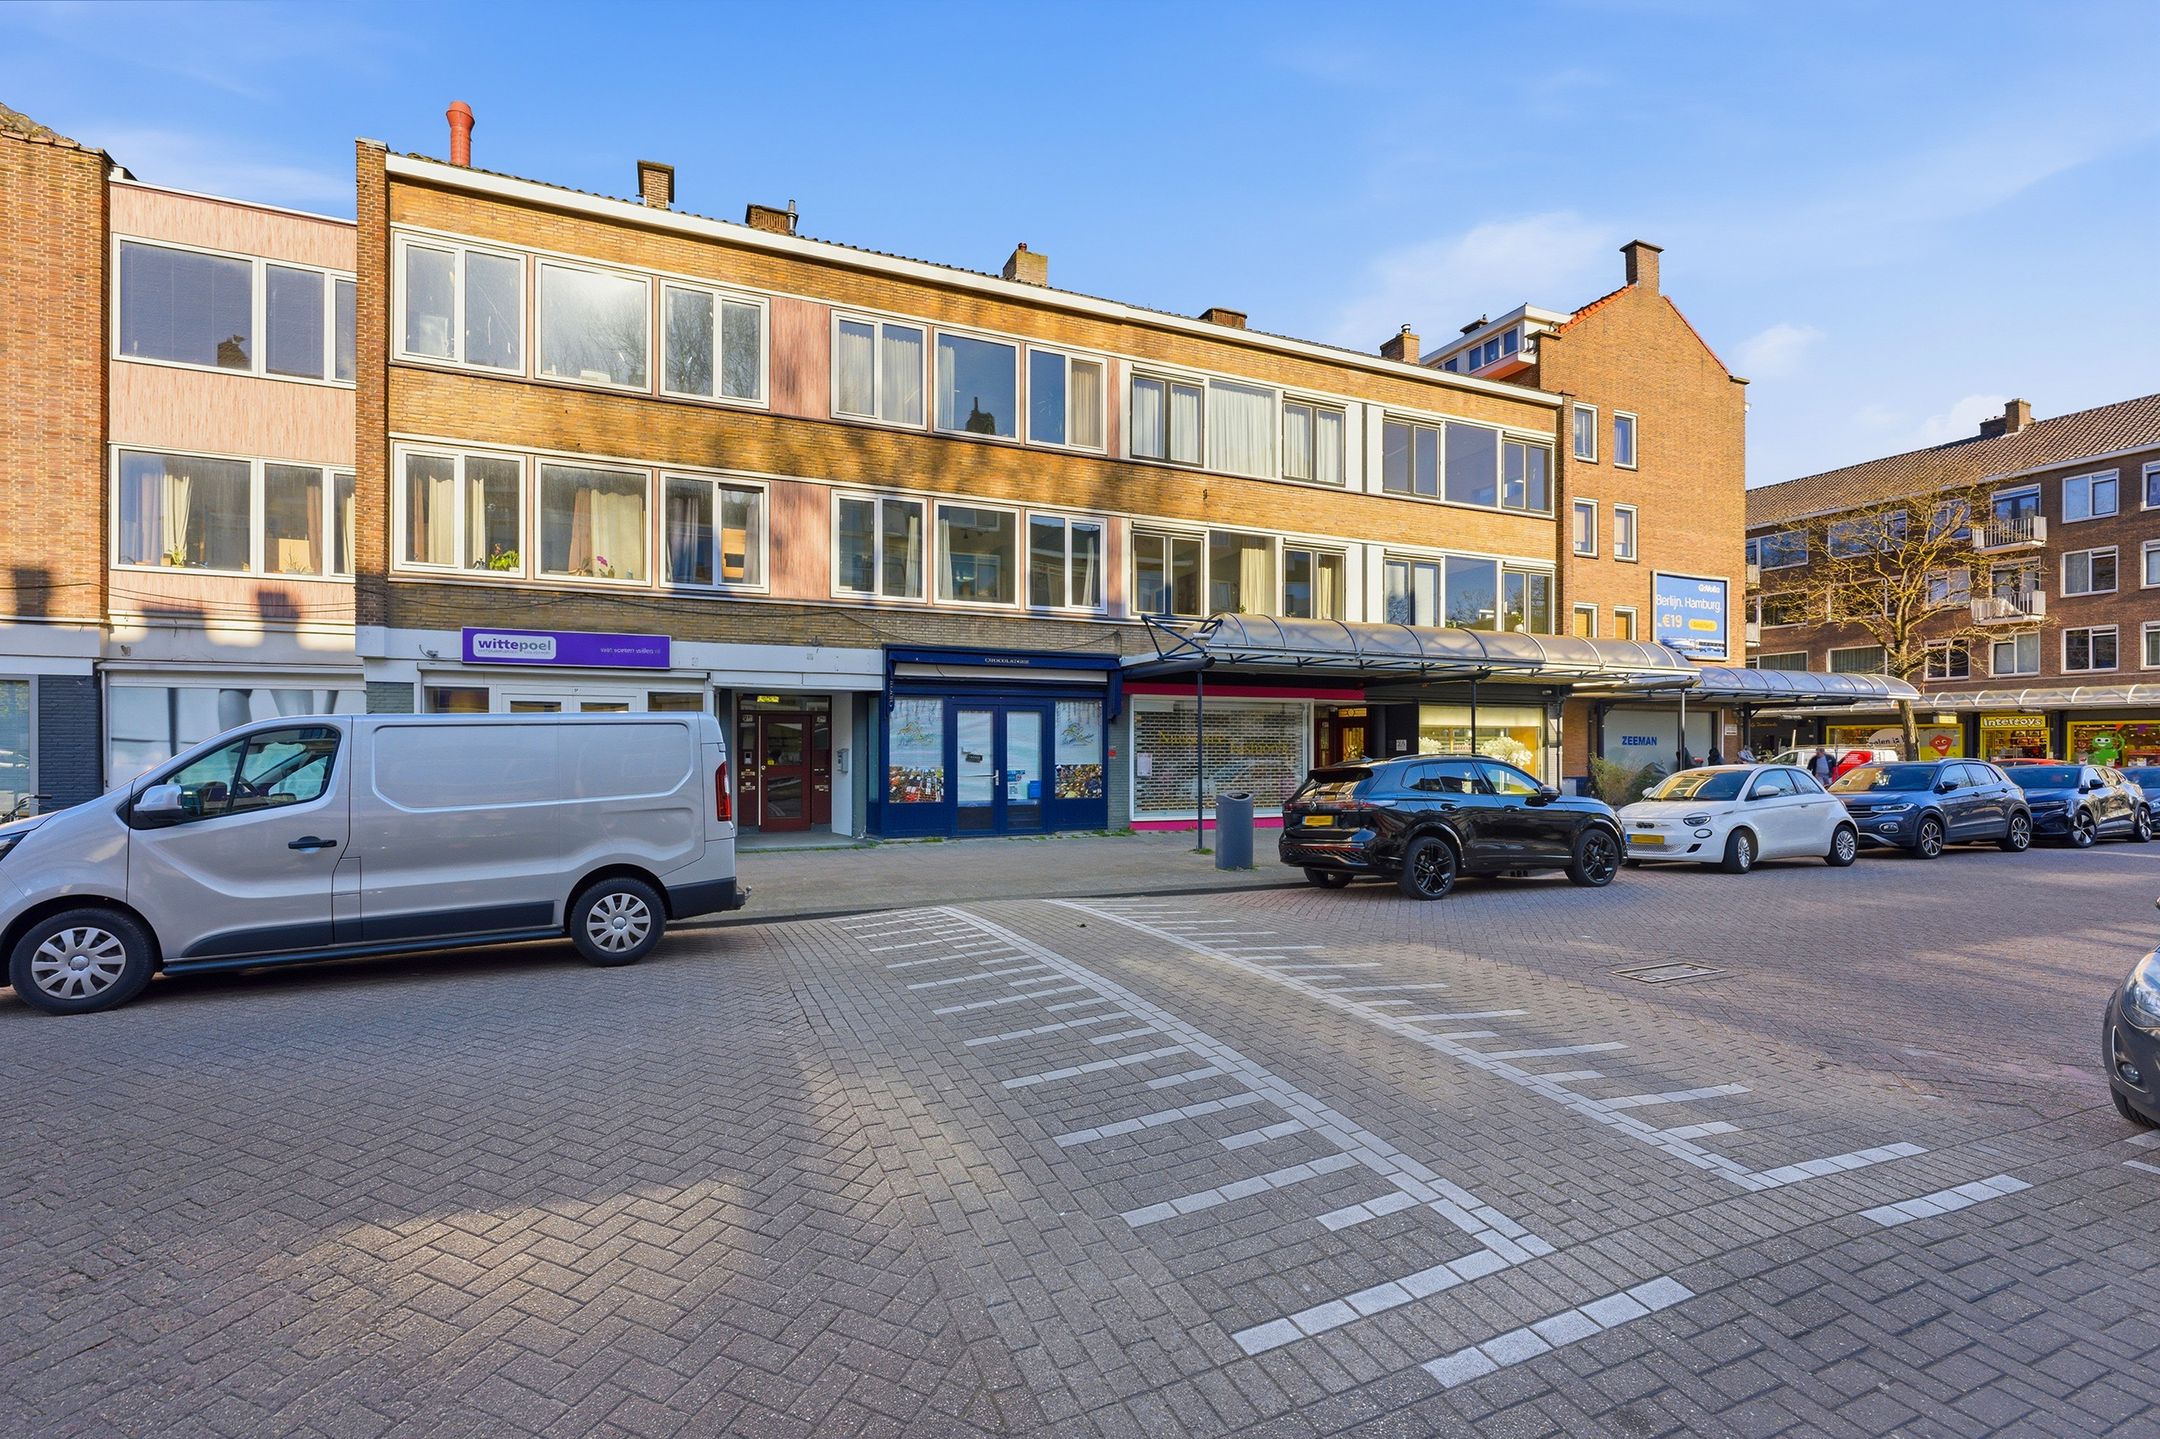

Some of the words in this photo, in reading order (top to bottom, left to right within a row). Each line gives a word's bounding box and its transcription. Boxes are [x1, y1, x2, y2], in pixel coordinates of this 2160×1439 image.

[1662, 613, 1683, 628] €19
[478, 638, 551, 652] wittepoel
[1984, 717, 2042, 728] Intertoys
[1621, 735, 1657, 746] ZEEMAN
